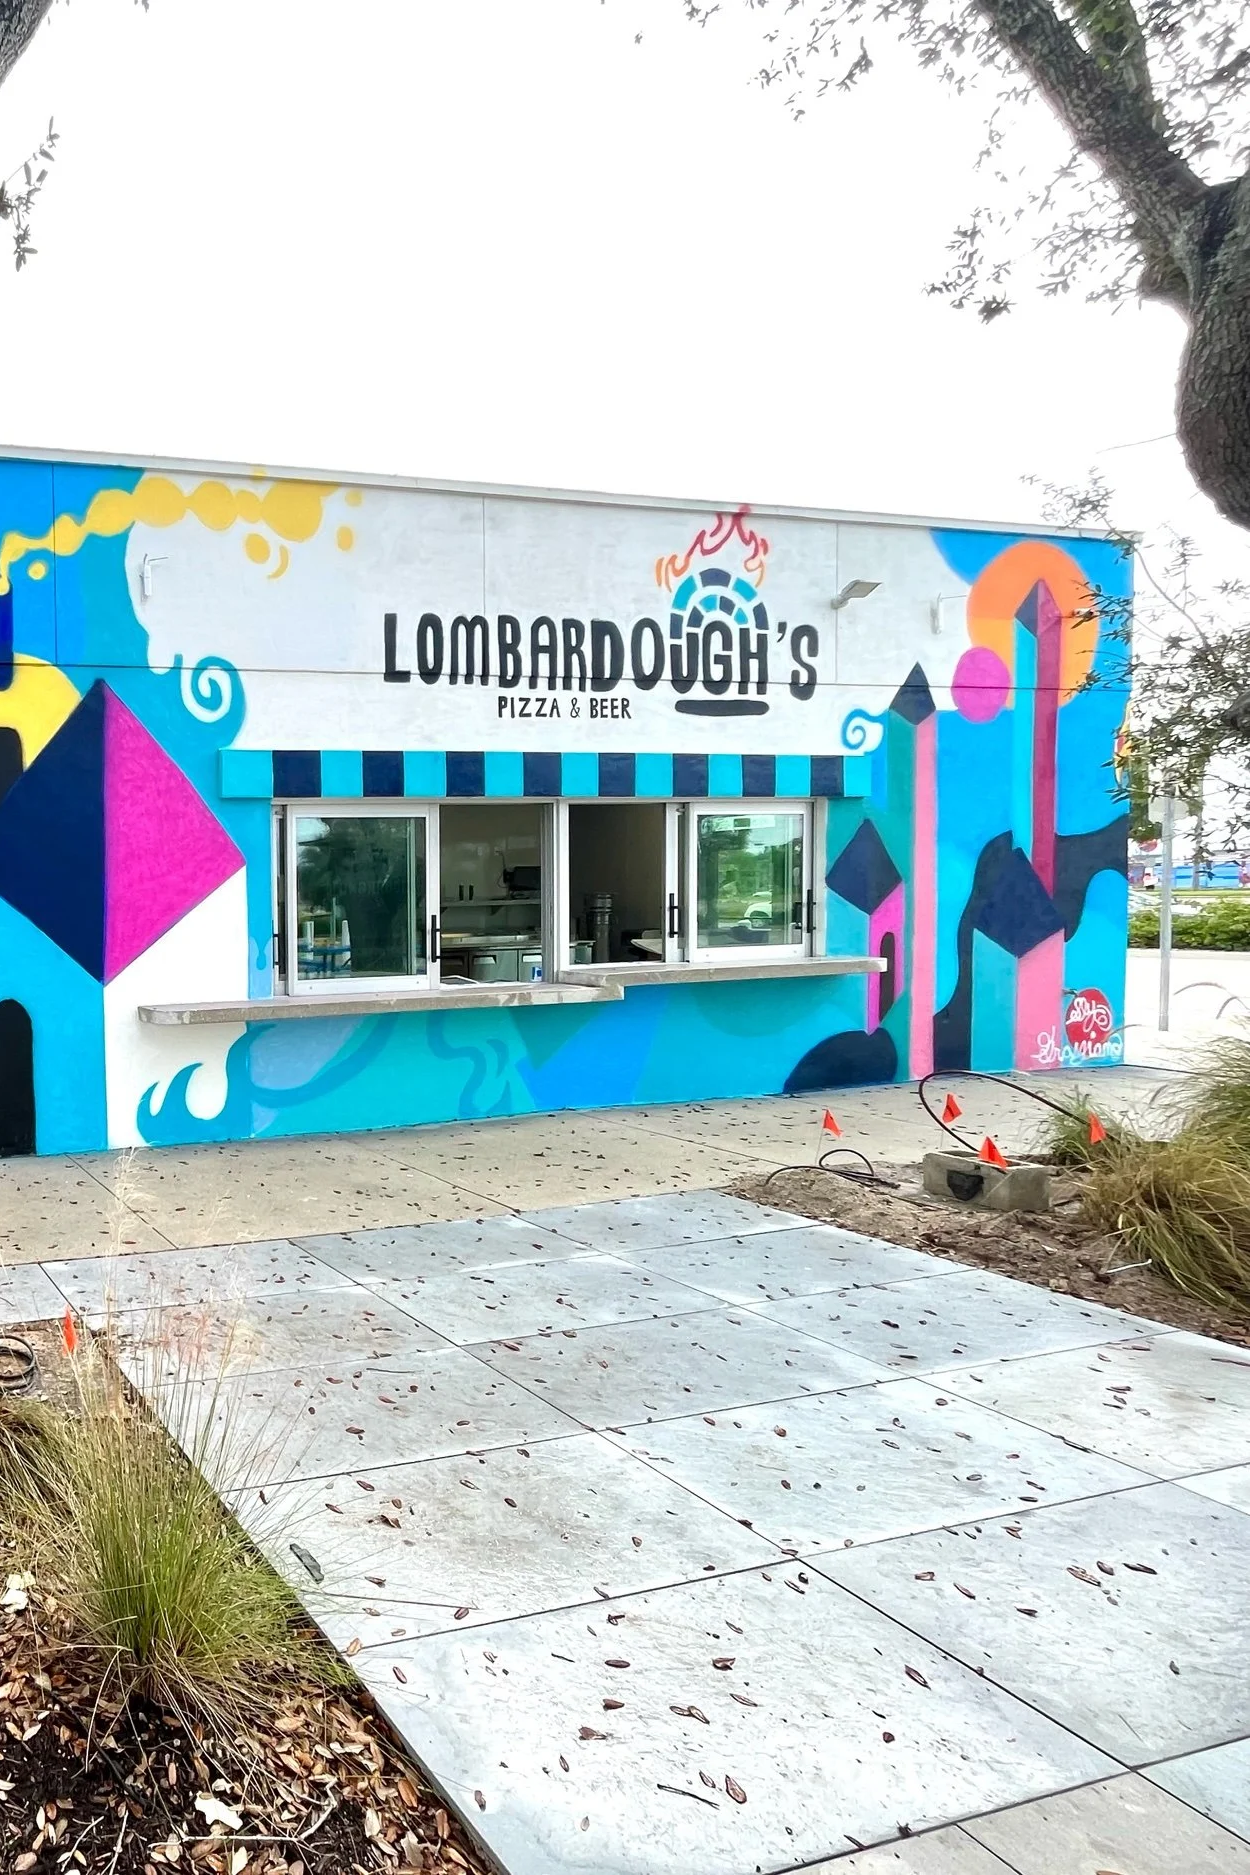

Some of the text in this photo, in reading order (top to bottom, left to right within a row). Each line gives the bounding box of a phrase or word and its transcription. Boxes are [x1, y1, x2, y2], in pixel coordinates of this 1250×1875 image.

[383, 612, 819, 700] LOMBARDOUGH'S
[498, 695, 632, 719] PIZZA & BEER
